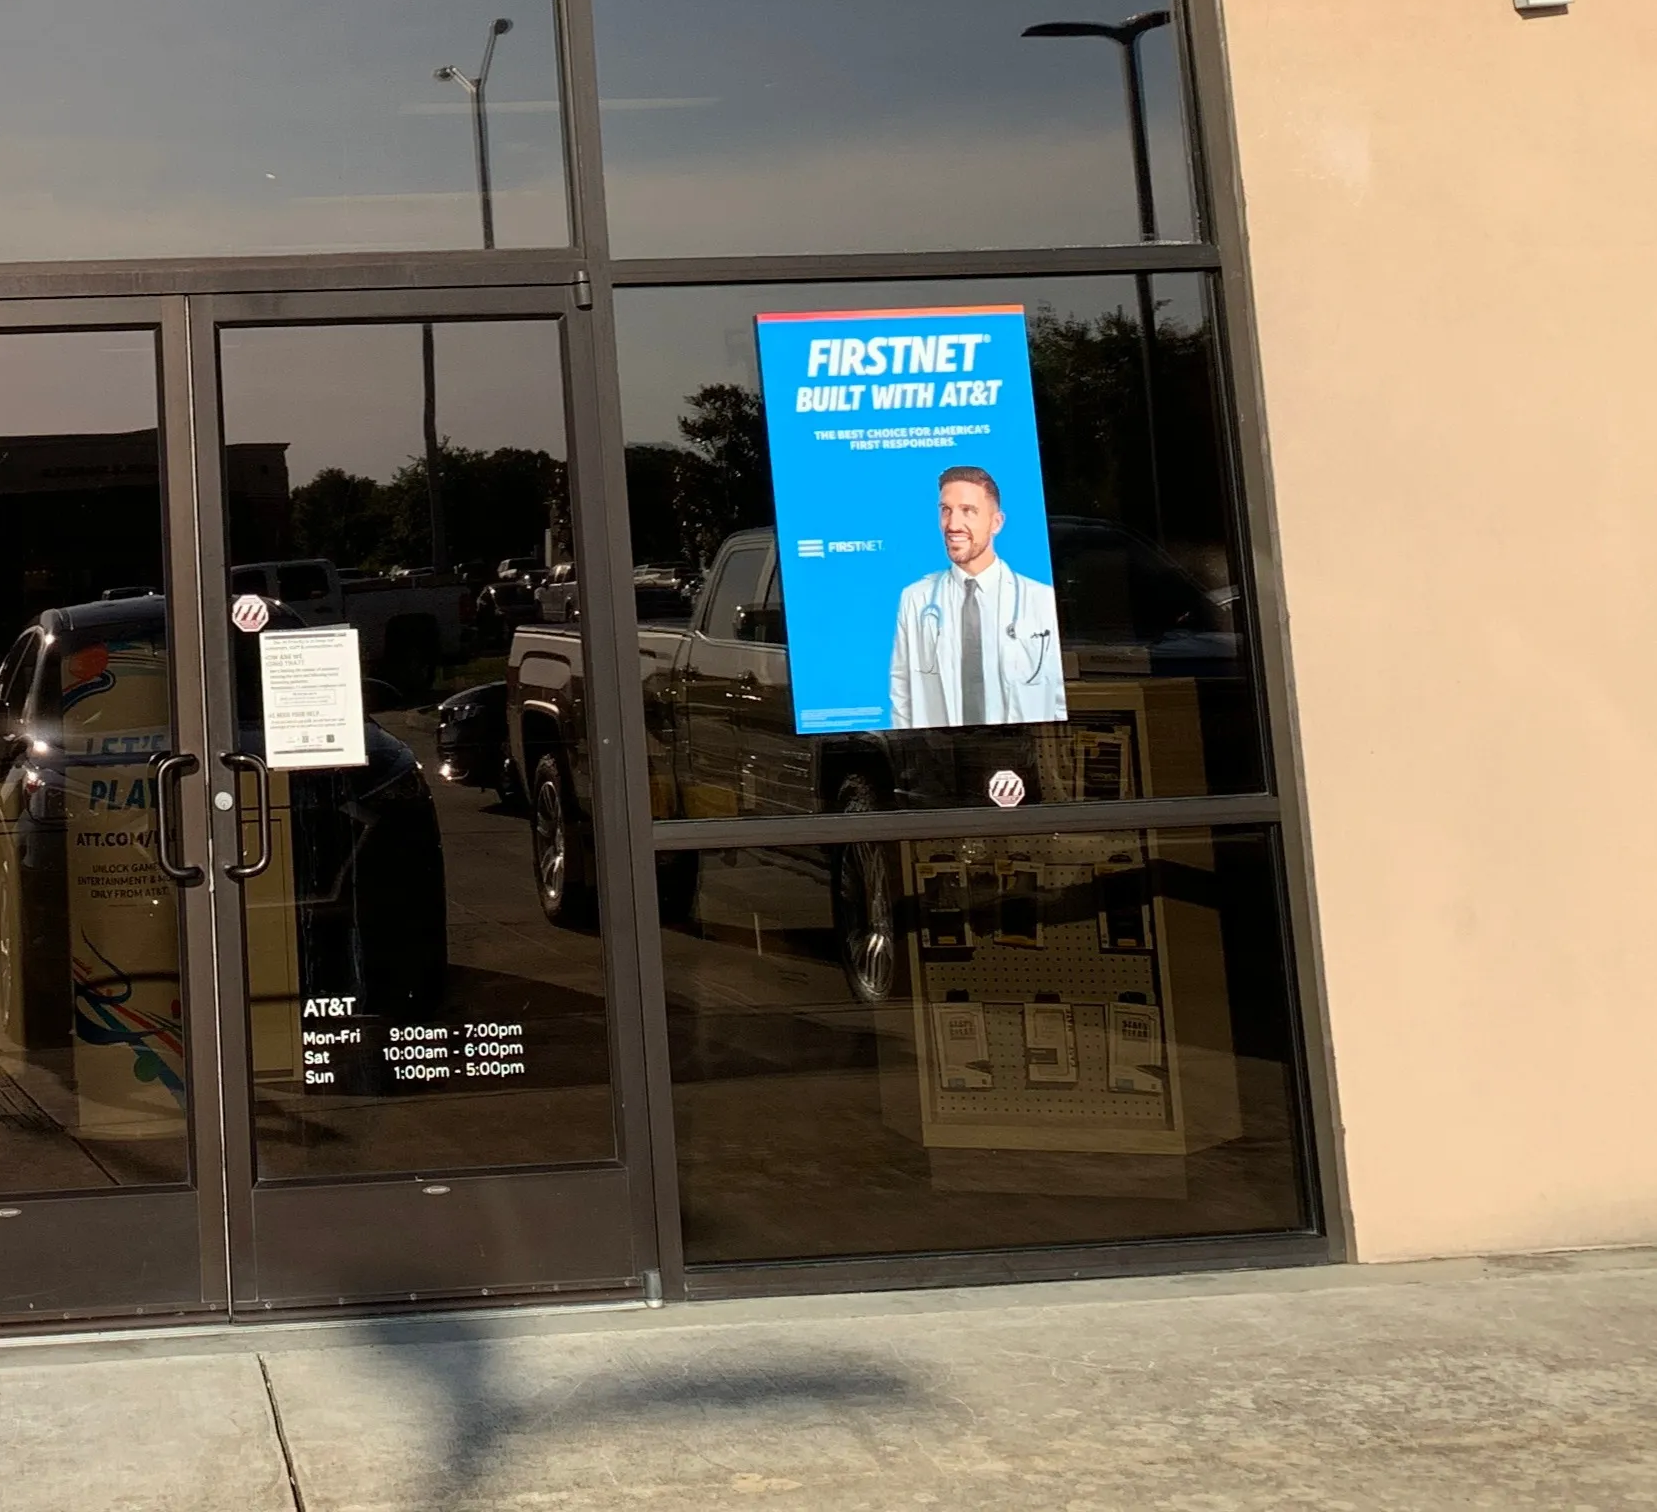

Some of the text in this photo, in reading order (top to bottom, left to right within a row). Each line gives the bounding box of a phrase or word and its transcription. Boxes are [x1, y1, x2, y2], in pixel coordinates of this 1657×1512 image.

[795, 379, 1003, 413] BUILT WITH AT&T
[814, 424, 991, 441] THE BEST CHOICE FOR AMERICA'S
[849, 437, 958, 451] FIRST RESPONDERS.
[92, 862, 158, 874] UNLOCK GAME
[77, 875, 148, 886] ENTERTAINMENT
[90, 888, 114, 899] ONLY
[114, 887, 143, 898] FROM
[303, 996, 357, 1018] AT&T
[302, 1028, 361, 1046] Mon-Fri
[389, 1026, 448, 1042] 9:00am
[464, 1023, 523, 1040] 7:00pm
[304, 1050, 330, 1065] Sat
[382, 1045, 448, 1061] 10:00am
[464, 1041, 524, 1059] 6:00pm
[305, 1069, 335, 1085] Sun
[393, 1064, 450, 1082] 1:00pm
[465, 1060, 525, 1078] 5:00pm
